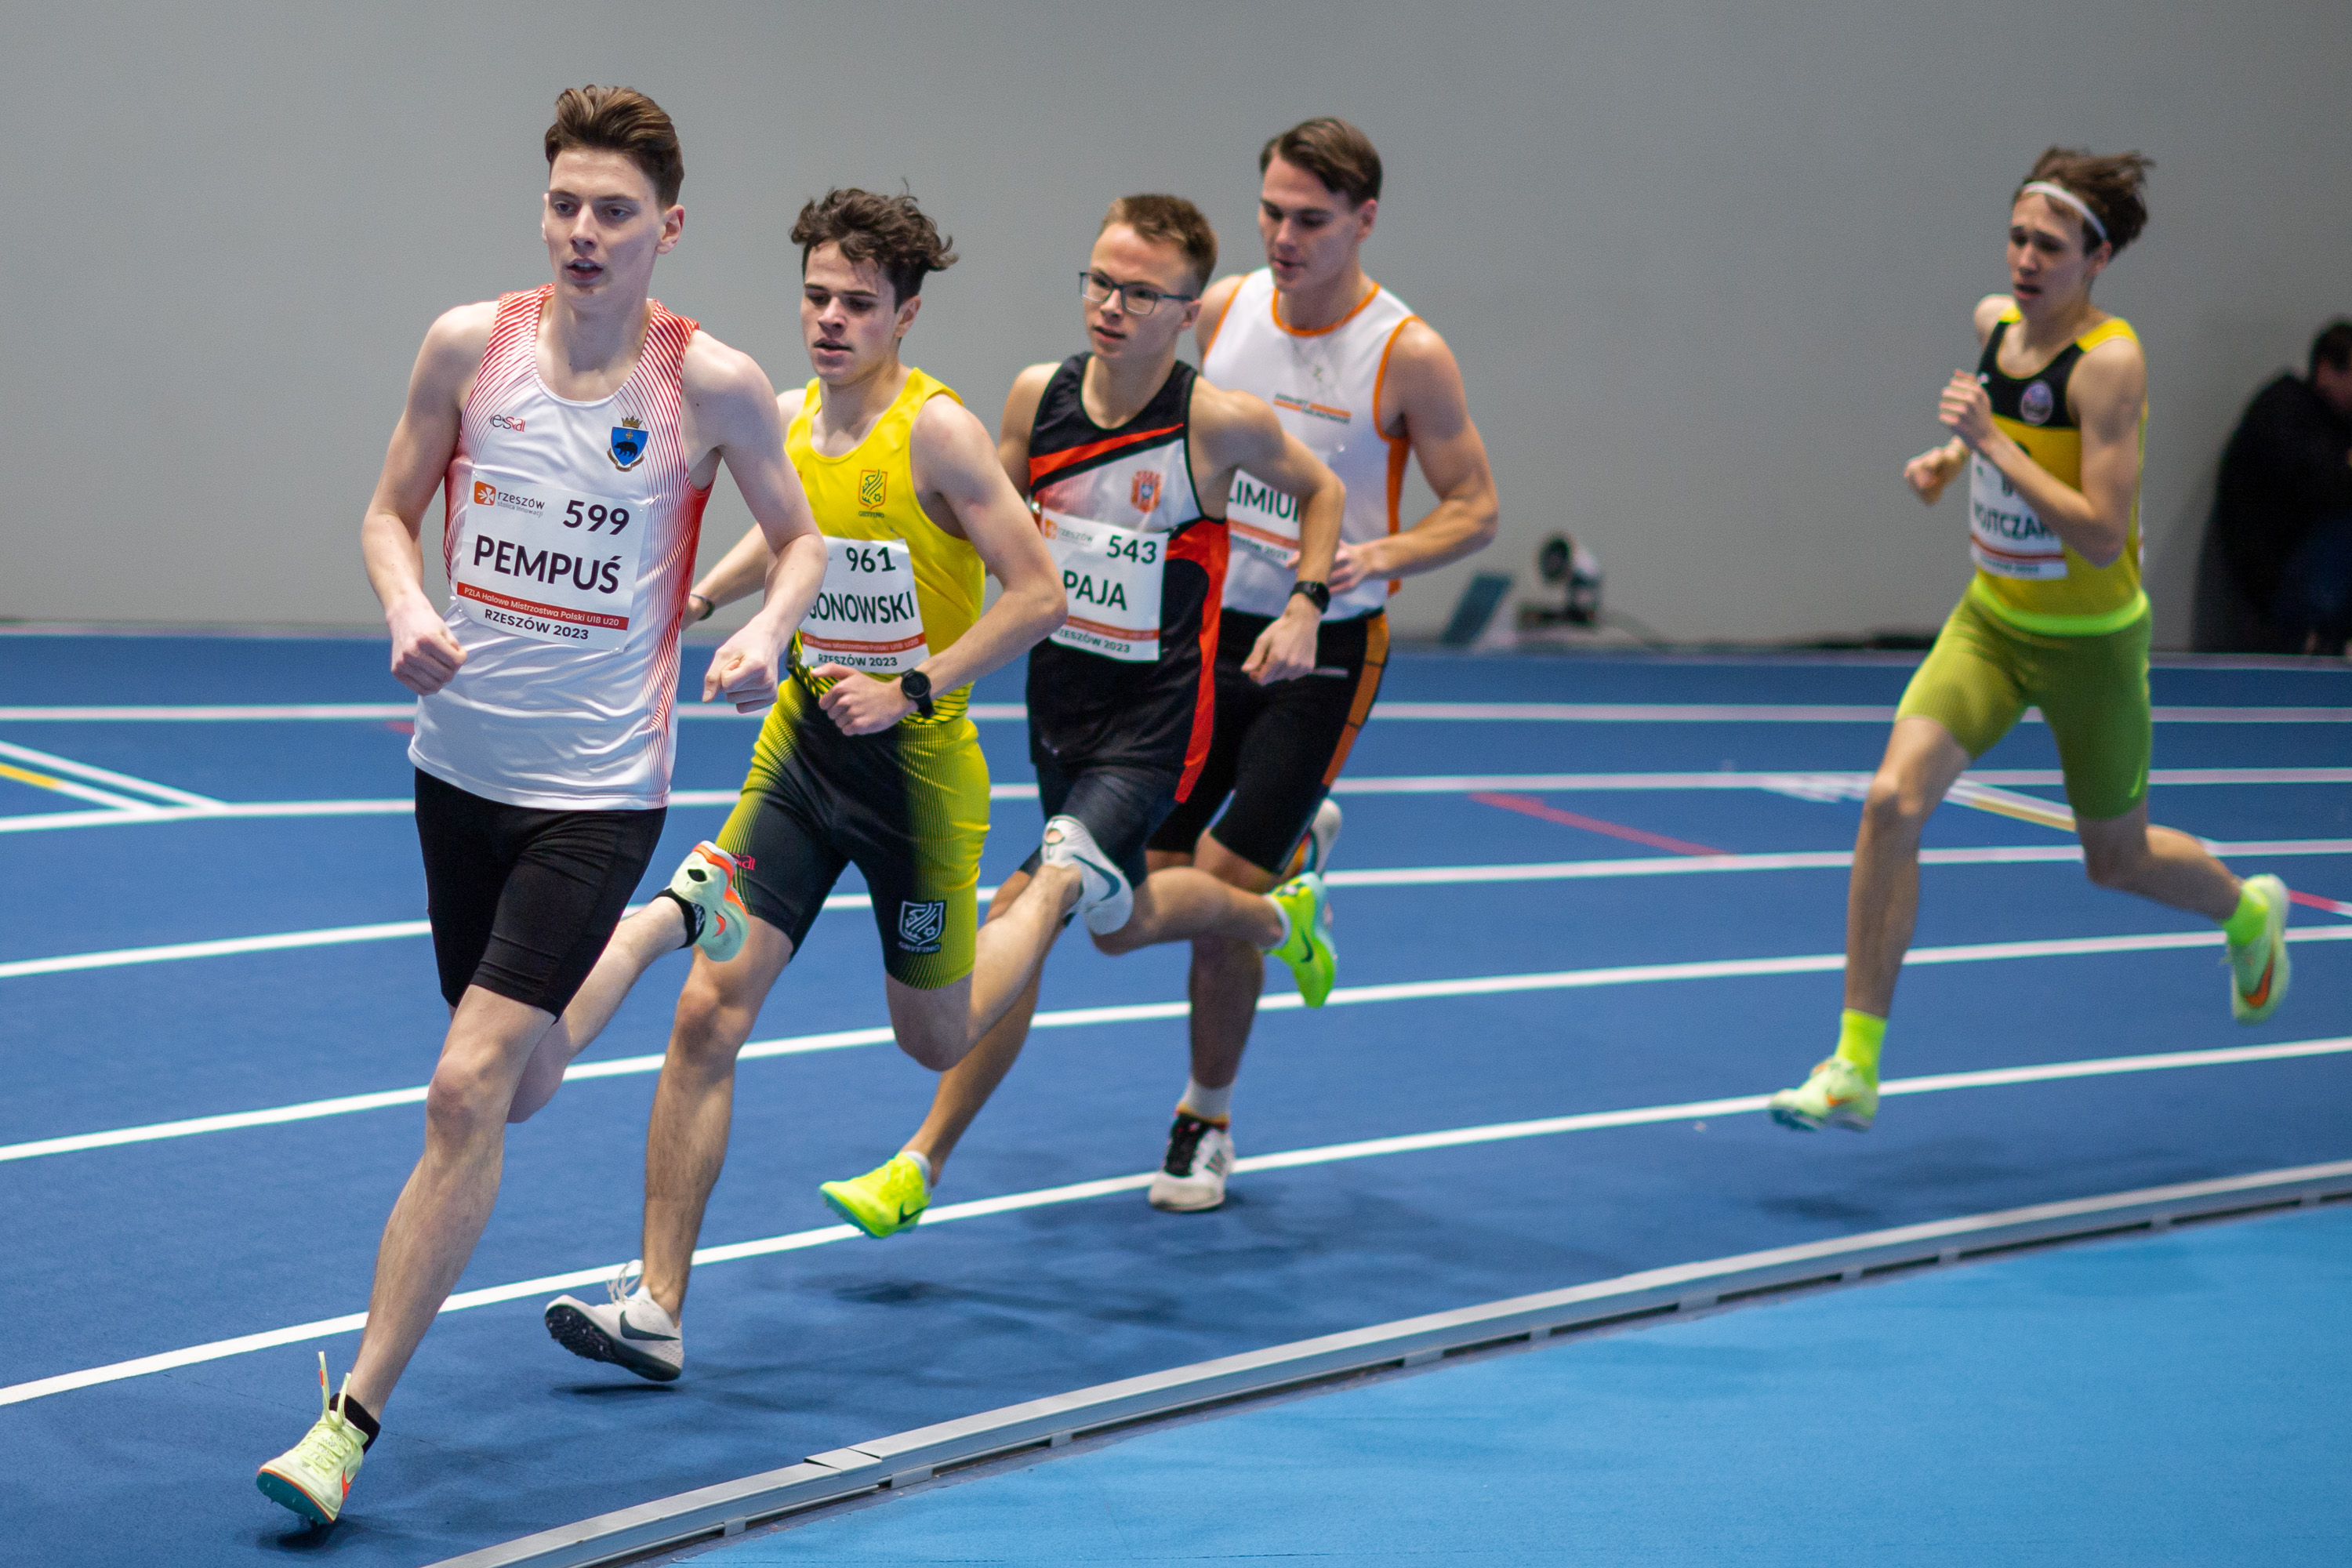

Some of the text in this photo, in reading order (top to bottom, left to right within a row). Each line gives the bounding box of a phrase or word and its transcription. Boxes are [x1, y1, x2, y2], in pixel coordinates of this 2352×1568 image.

[498, 492, 545, 510] rzeszów
[563, 499, 630, 535] 599
[1229, 480, 1298, 522] IMIU
[474, 534, 622, 593] PEMPUŚ
[845, 546, 896, 573] 961
[1106, 535, 1157, 564] 543
[1063, 569, 1127, 611] PAJA
[464, 587, 481, 599] PZLA
[482, 592, 509, 607] Halowe
[510, 601, 559, 617] Mistrzostwa
[561, 611, 585, 622] Polski
[603, 618, 619, 626] U20
[485, 608, 590, 640] RZESZÓW 2023
[1056, 629, 1131, 653] ZESZÓW 2023
[818, 653, 898, 666] RZESZÓW 2023
